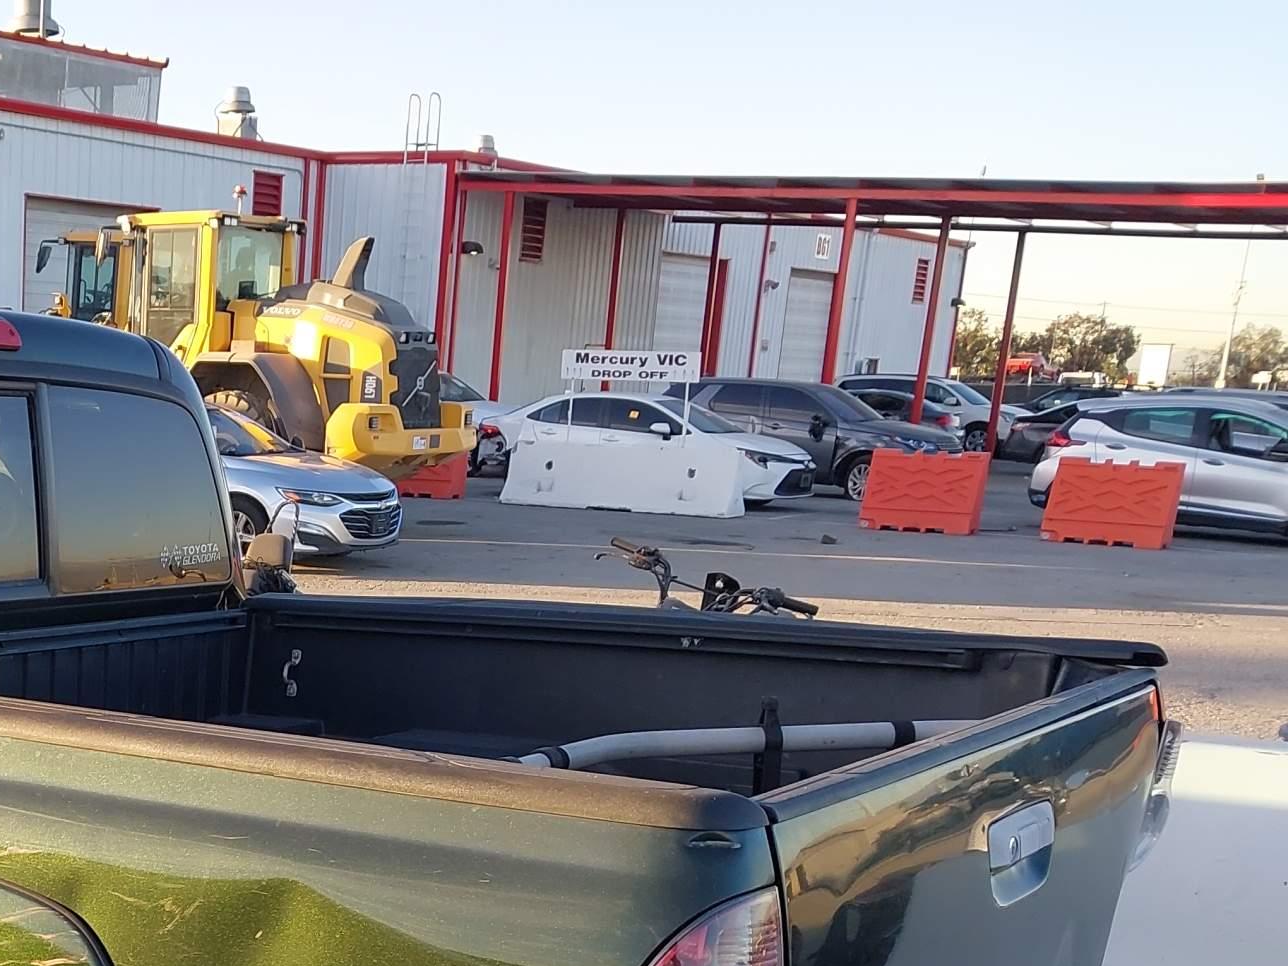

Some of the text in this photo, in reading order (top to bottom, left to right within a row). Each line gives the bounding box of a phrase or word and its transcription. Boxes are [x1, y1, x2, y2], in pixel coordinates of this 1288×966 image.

[262, 306, 301, 315] VOLVO
[575, 352, 688, 367] Mercury VIC
[591, 369, 669, 379] DROP OFF
[364, 375, 377, 398] L90H
[182, 543, 219, 555] TOYOTA
[182, 552, 221, 566] GLENDORA
